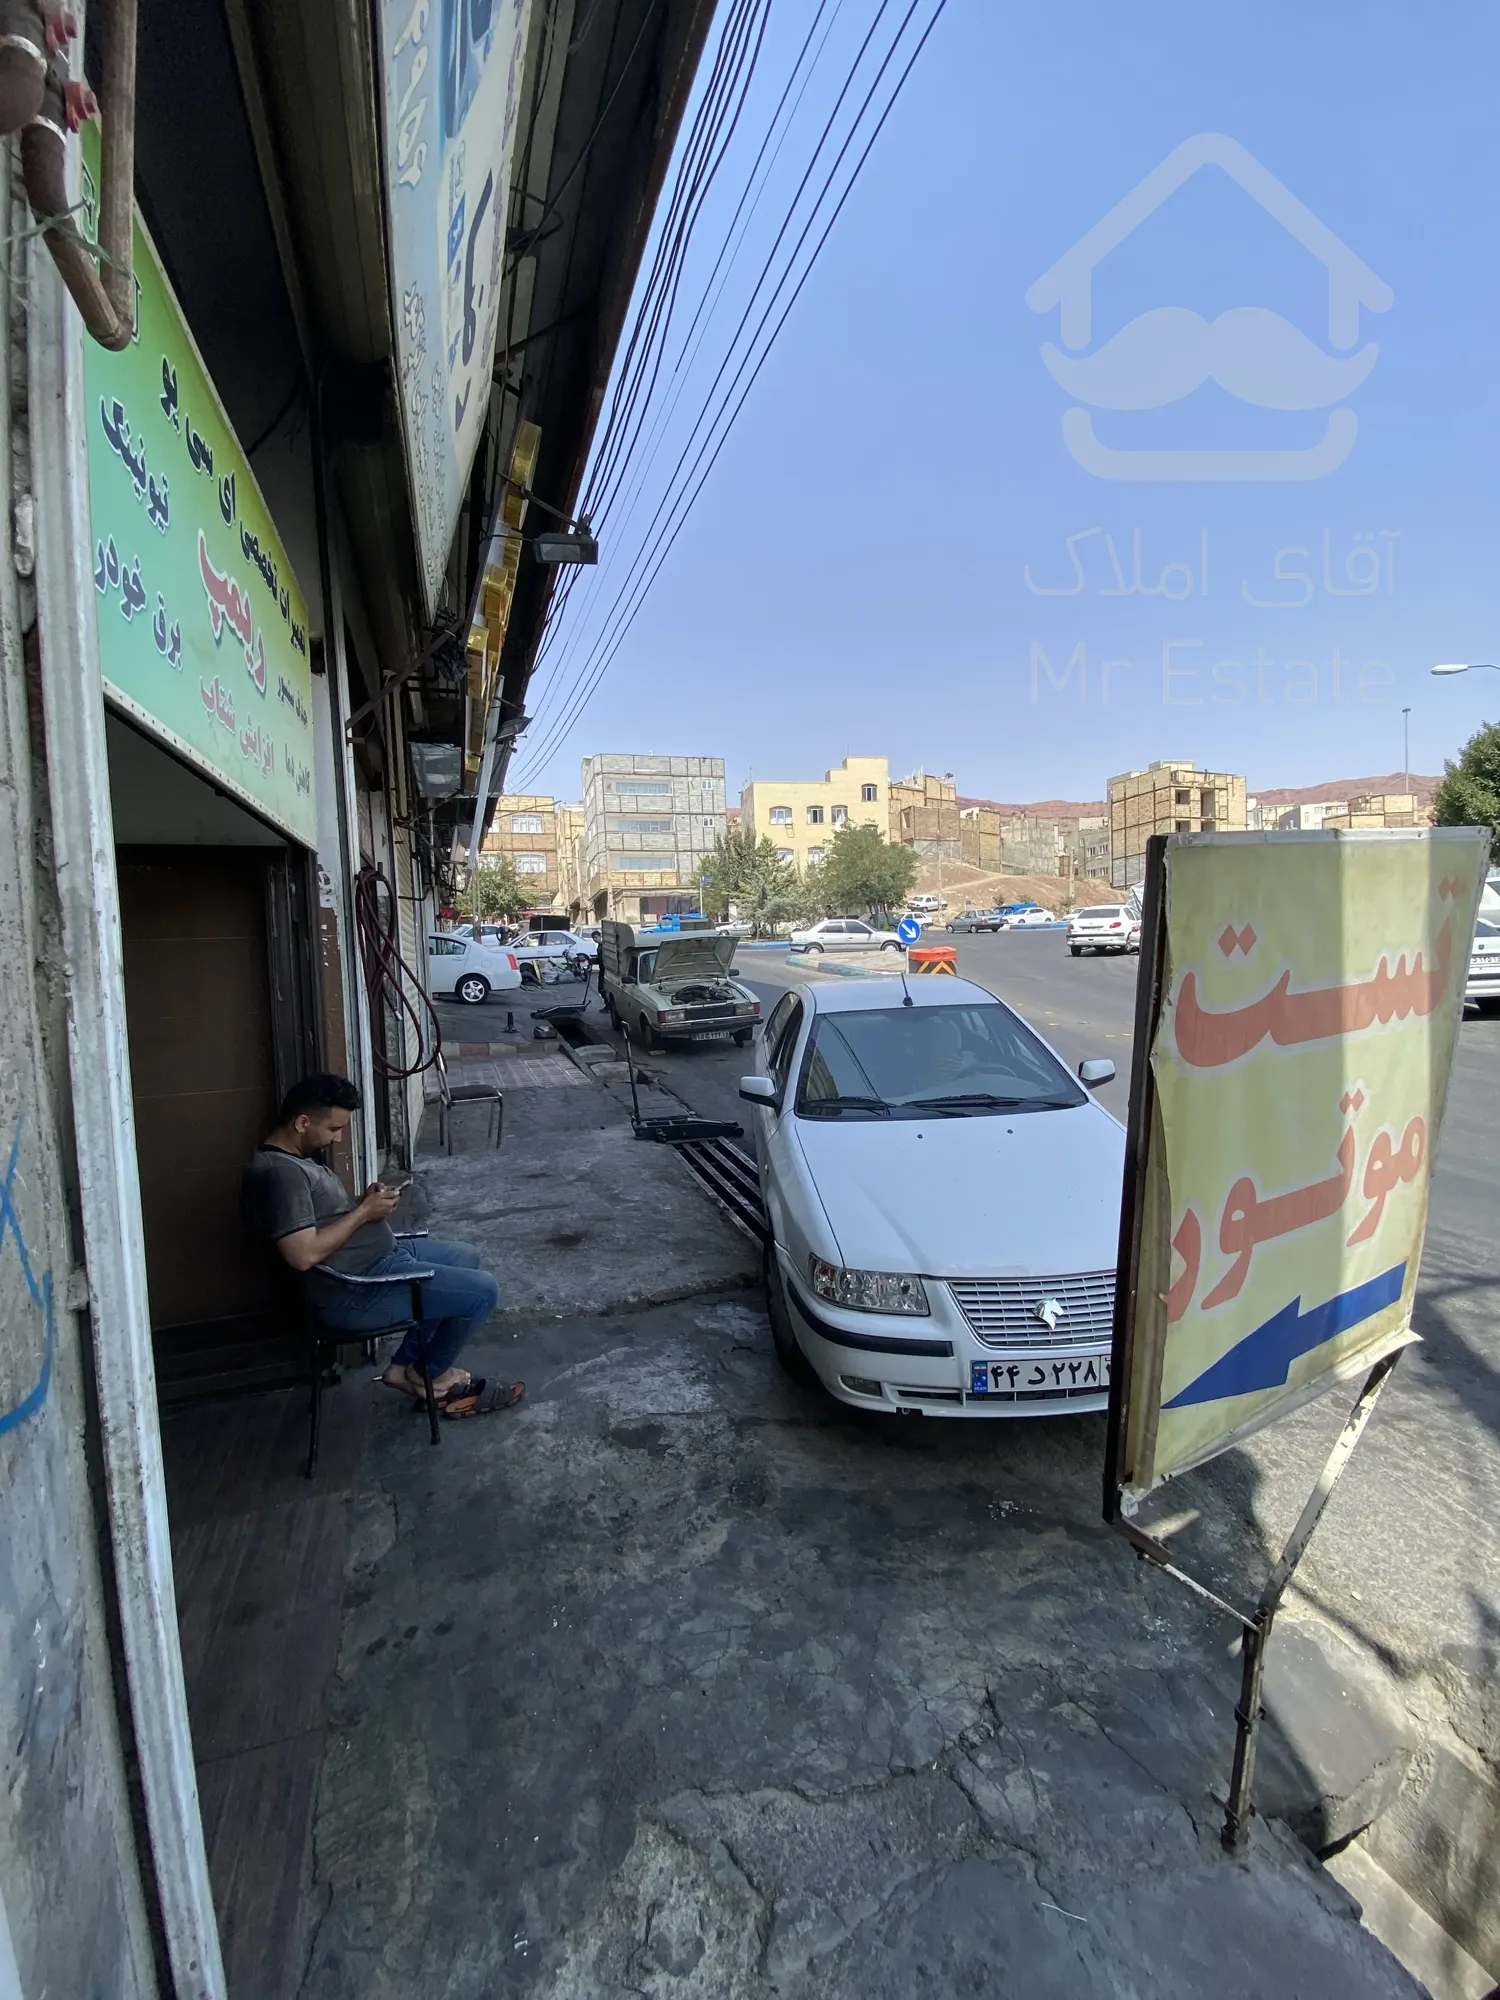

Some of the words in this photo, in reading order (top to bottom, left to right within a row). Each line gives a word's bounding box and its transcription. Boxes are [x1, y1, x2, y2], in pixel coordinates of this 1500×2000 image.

[454, 167, 494, 435] رضا
[159, 354, 181, 436] یو
[98, 394, 171, 535] تیونینگ
[185, 411, 214, 481] سی
[216, 467, 237, 528] ای
[239, 517, 279, 607] تخصصی
[152, 590, 184, 673] برق
[198, 526, 267, 693] ریمپ
[199, 675, 236, 736] شتاب
[239, 711, 275, 780] افزایش
[1173, 874, 1466, 1069] تست
[1166, 1087, 1426, 1324] موتور
